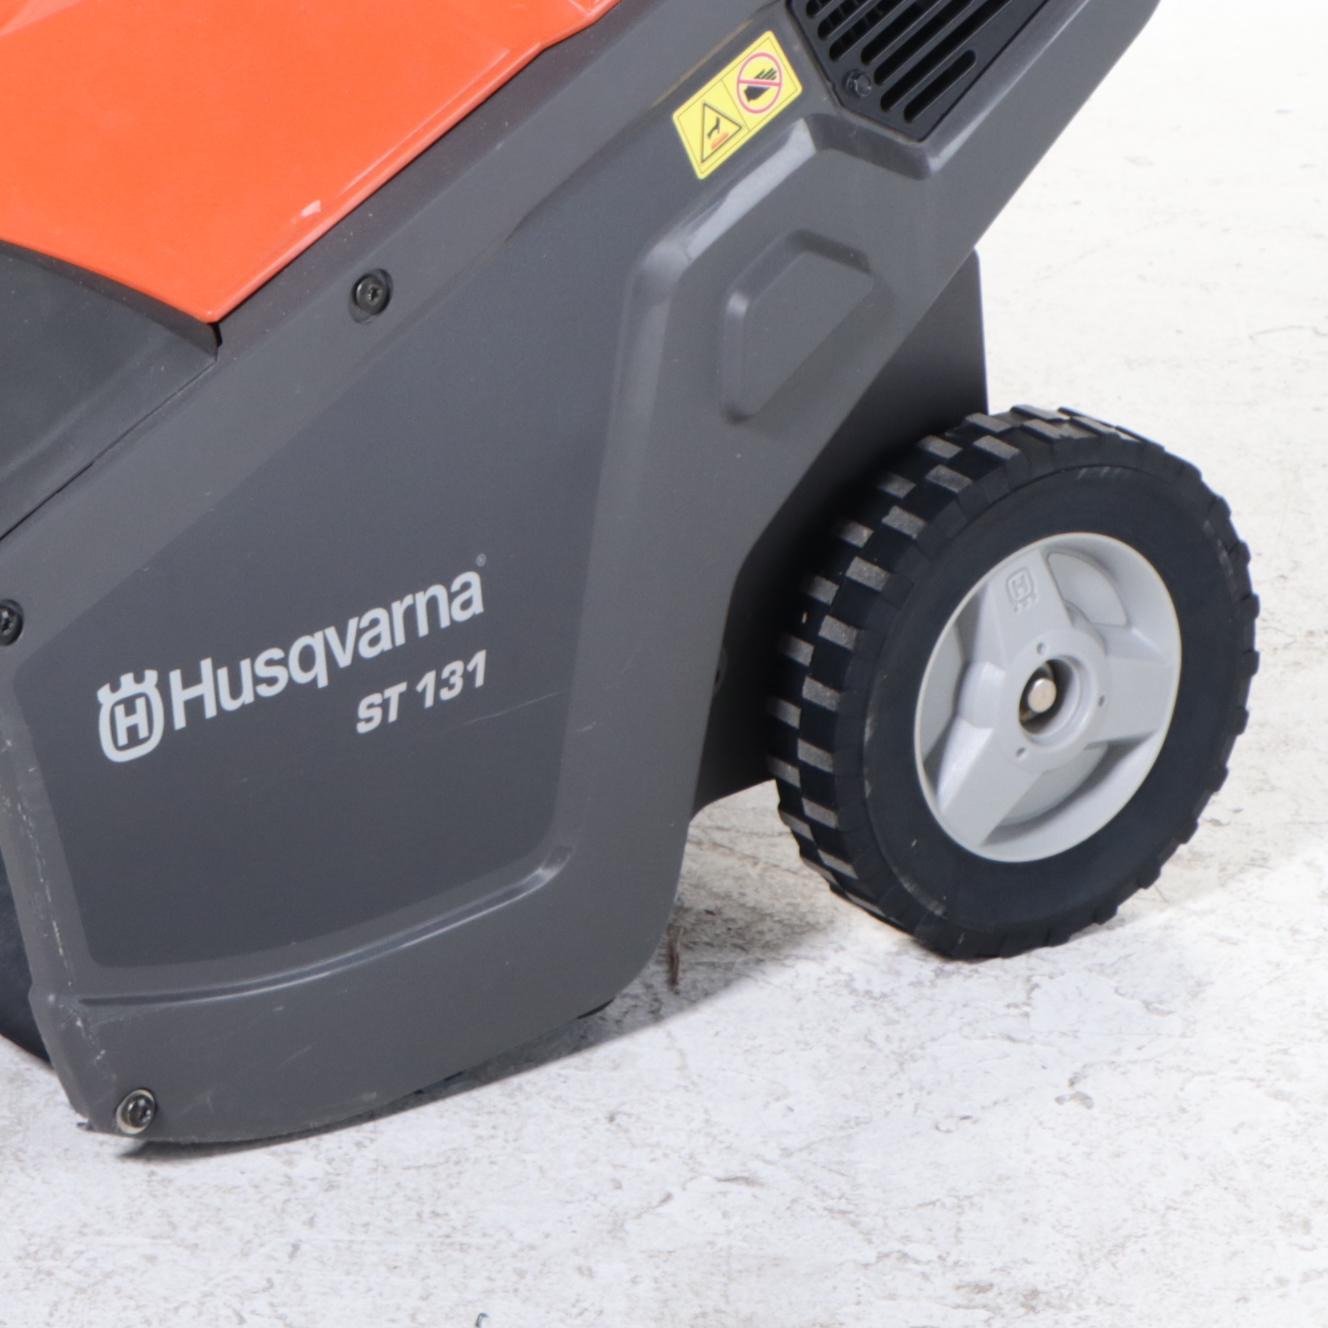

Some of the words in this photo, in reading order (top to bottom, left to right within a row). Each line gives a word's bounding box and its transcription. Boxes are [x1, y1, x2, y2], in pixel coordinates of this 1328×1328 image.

[169, 569, 485, 730] Husqvarna
[356, 682, 410, 735] ST
[416, 649, 488, 709] 131
